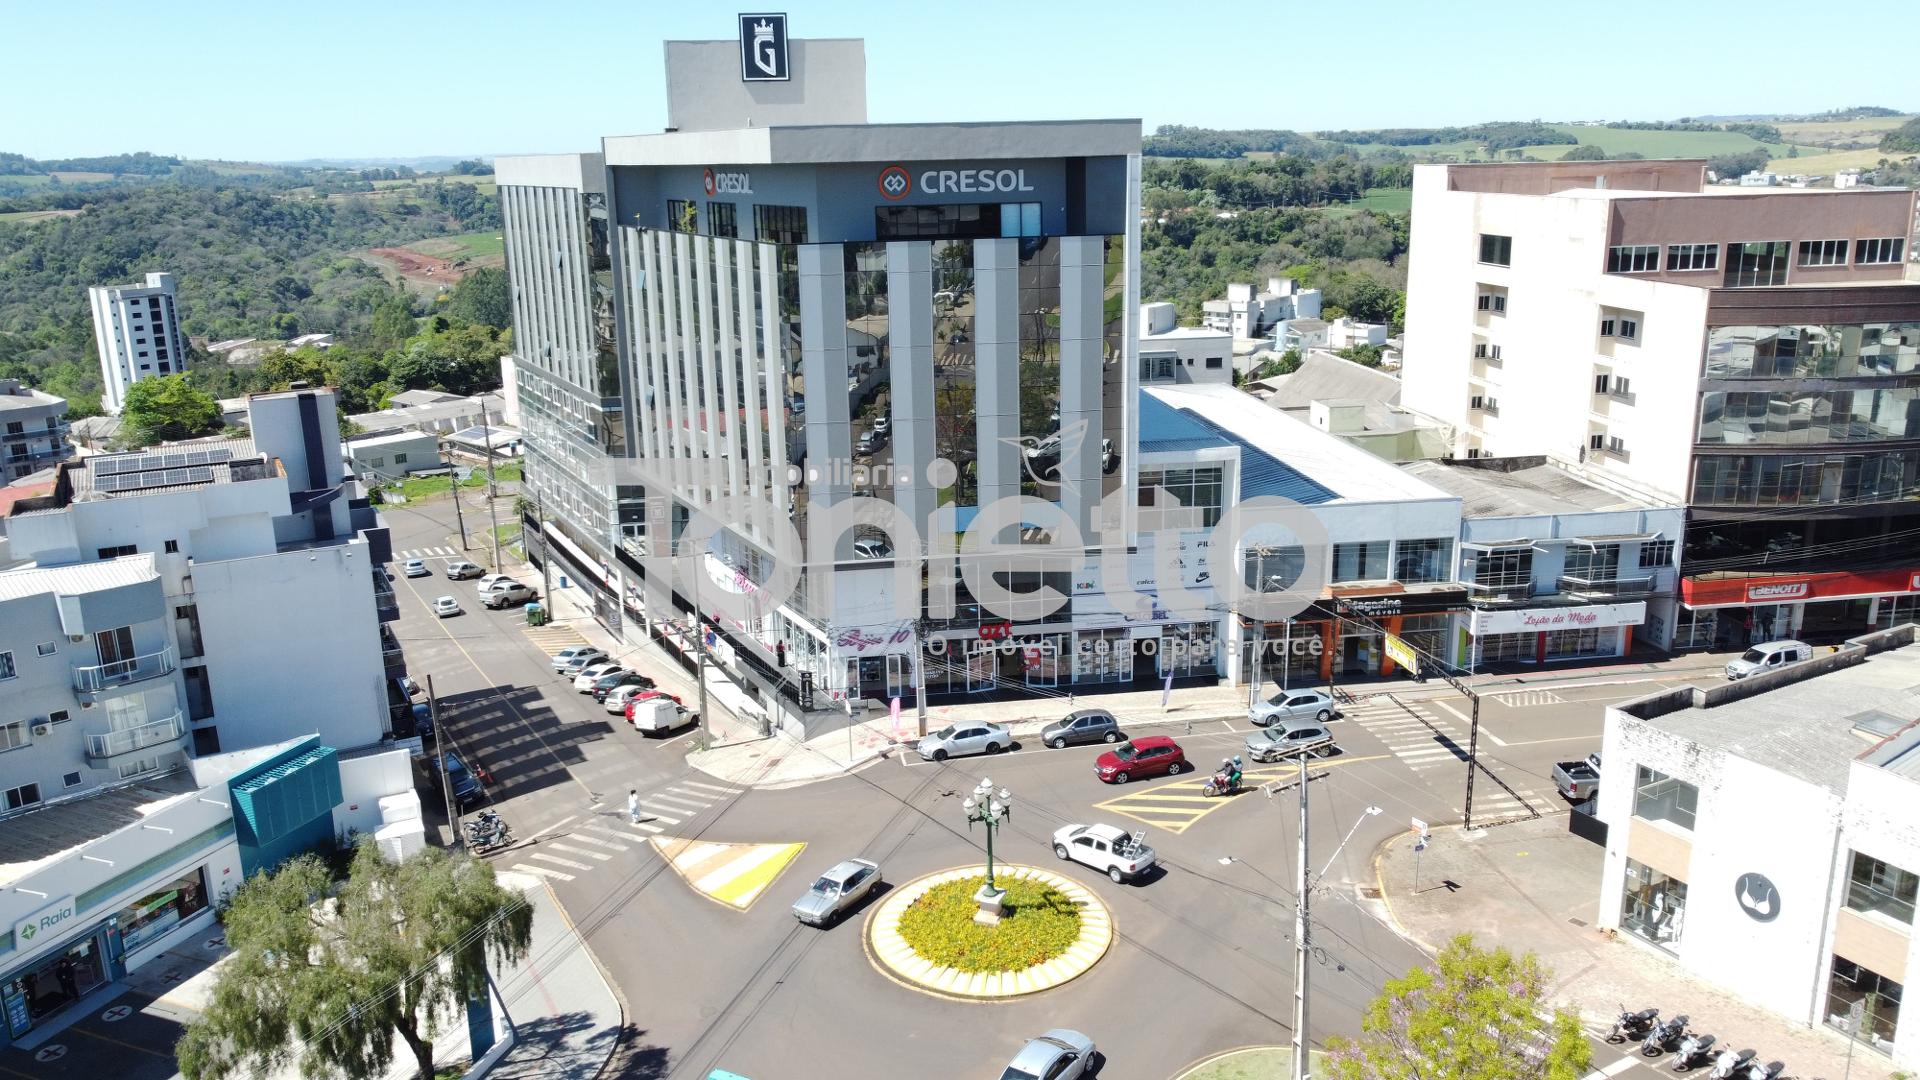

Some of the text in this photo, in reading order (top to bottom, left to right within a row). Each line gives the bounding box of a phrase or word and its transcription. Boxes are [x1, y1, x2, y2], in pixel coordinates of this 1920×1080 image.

[753, 34, 777, 77] G
[715, 172, 754, 194] CRESOL
[920, 168, 1035, 194] CRESOL
[1755, 583, 1801, 596] BENOIT
[1552, 613, 1565, 624] da
[1567, 611, 1597, 624] Moda
[39, 907, 72, 931] Raia
